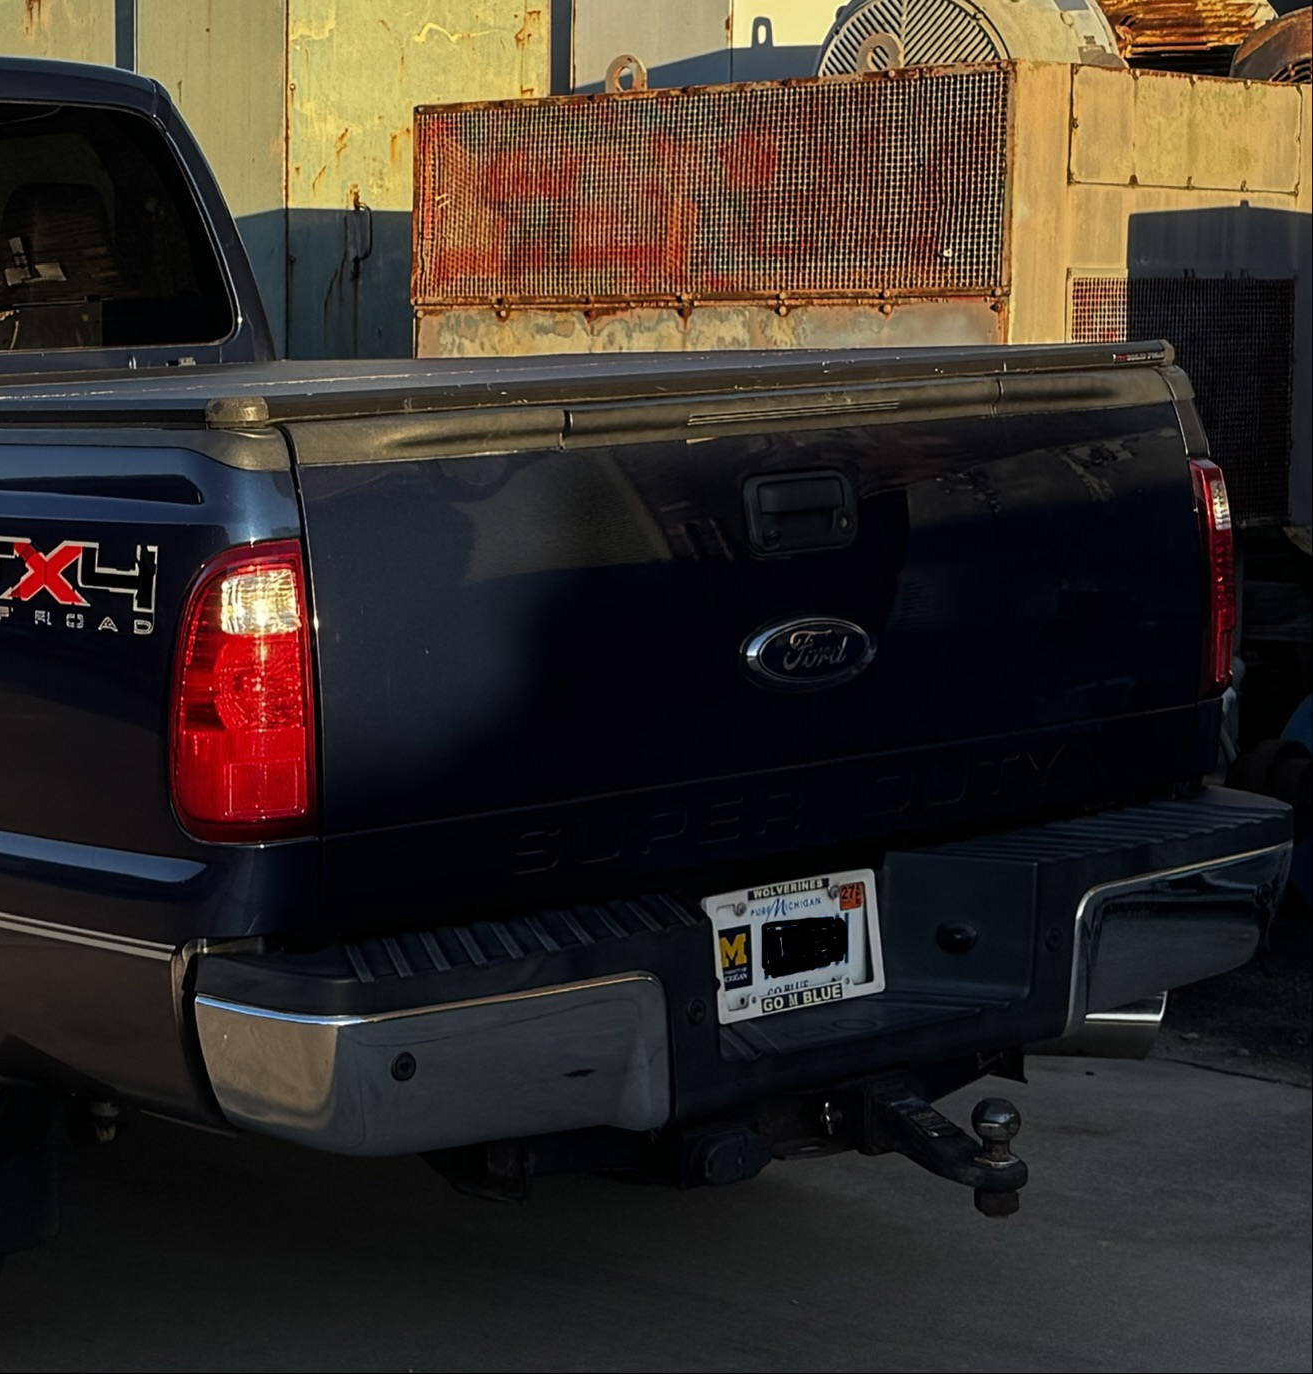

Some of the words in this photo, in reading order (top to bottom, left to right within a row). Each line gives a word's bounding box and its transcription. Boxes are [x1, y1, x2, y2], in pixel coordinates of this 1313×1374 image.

[783, 629, 848, 671] Ford
[752, 879, 824, 899] WOLVERINES
[840, 885, 855, 899] 27
[719, 932, 748, 968] M
[762, 996, 784, 1012] GO
[802, 984, 842, 1004] BLUE
